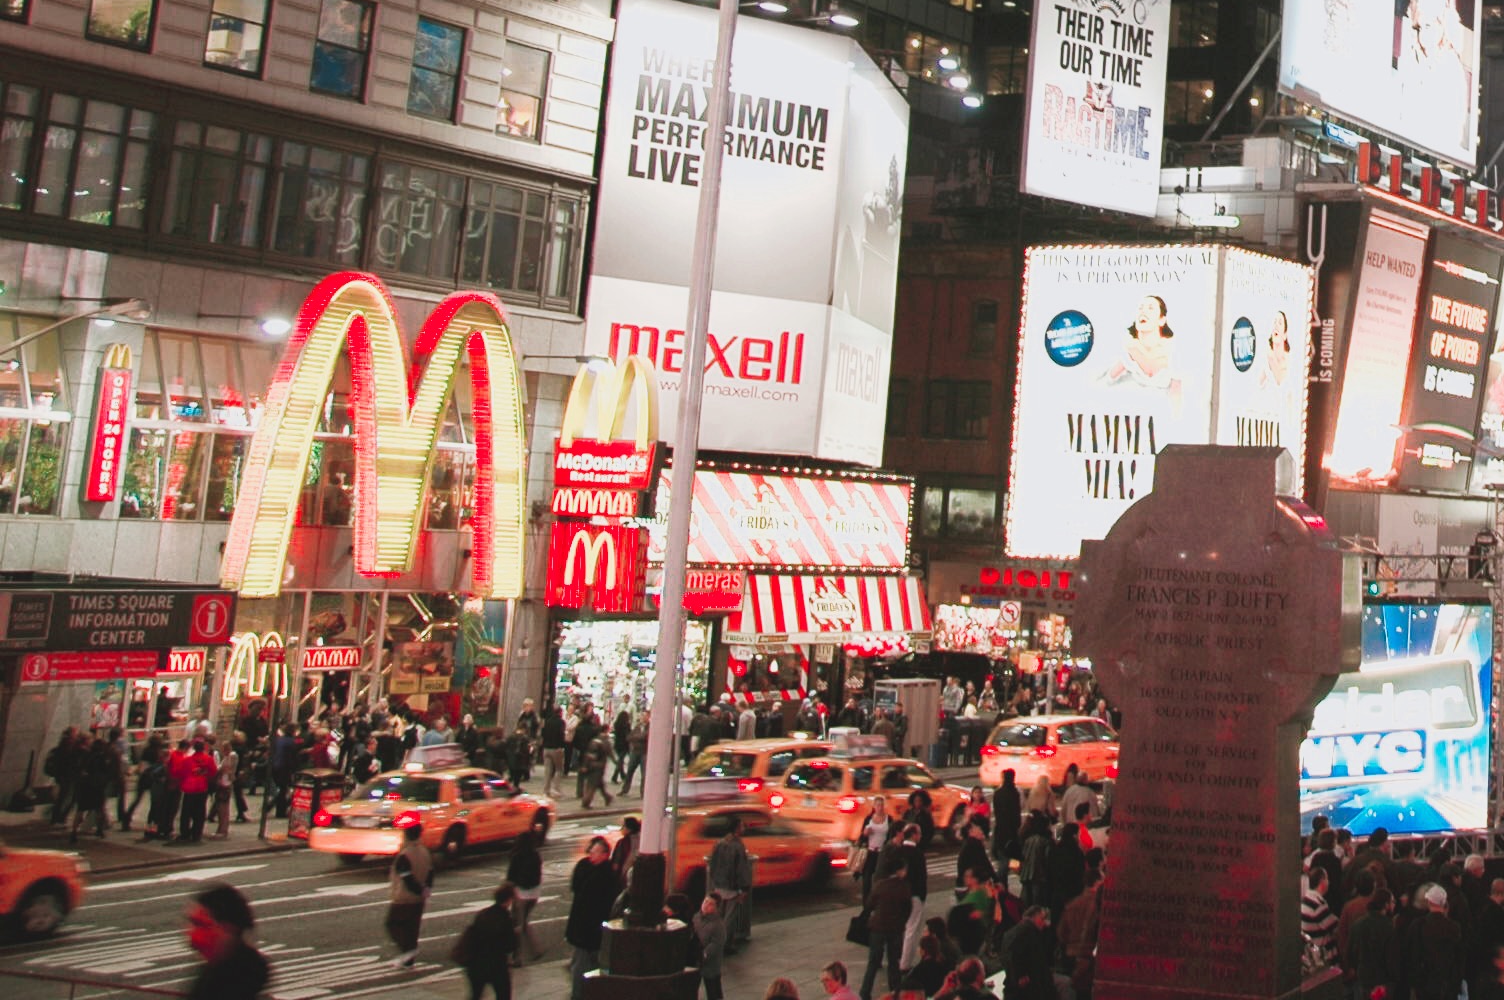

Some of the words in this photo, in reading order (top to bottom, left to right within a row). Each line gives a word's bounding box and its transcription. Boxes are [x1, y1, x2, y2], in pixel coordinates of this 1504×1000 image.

[1054, 4, 1104, 45] THEIR
[1110, 19, 1154, 58] TIME
[1060, 40, 1094, 76] OUR
[1099, 50, 1143, 88] TIME
[1042, 83, 1152, 161] RAGTIME
[632, 114, 825, 171] PERFRMANCE
[627, 144, 701, 187] LIVE
[1366, 250, 1385, 269] HELP
[1387, 256, 1416, 278] WANTED
[1431, 296, 1451, 321] THE
[1450, 299, 1488, 333] FUTURE
[608, 322, 805, 385] maxell
[1320, 318, 1335, 365] COMING
[1431, 331, 1444, 358] OF
[1443, 333, 1480, 366] POWER
[835, 342, 882, 404] maxell
[108, 376, 124, 421] OPEN
[103, 424, 121, 435] 24
[1065, 413, 1157, 454] MAMMA
[98, 437, 116, 495] HOURS
[556, 453, 647, 472] McDonald's
[570, 471, 630, 484] Restaurant
[1081, 459, 1137, 500] MIA!
[69, 594, 115, 610] TIMES
[119, 594, 175, 610] SQUARE
[1127, 584, 1201, 606] FRANCIS
[1224, 589, 1289, 611] DUFFY
[69, 612, 169, 628] INFORMATION
[90, 630, 145, 645] CENTER
[1144, 632, 1208, 648] CATHOLIC
[1216, 635, 1264, 650] PRIEST
[1170, 667, 1234, 683] CHAPLAIN
[1207, 744, 1258, 760] SERVICE
[1299, 732, 1425, 777] NYC
[1167, 769, 1194, 783] AND
[1200, 772, 1260, 789] COUNTRY
